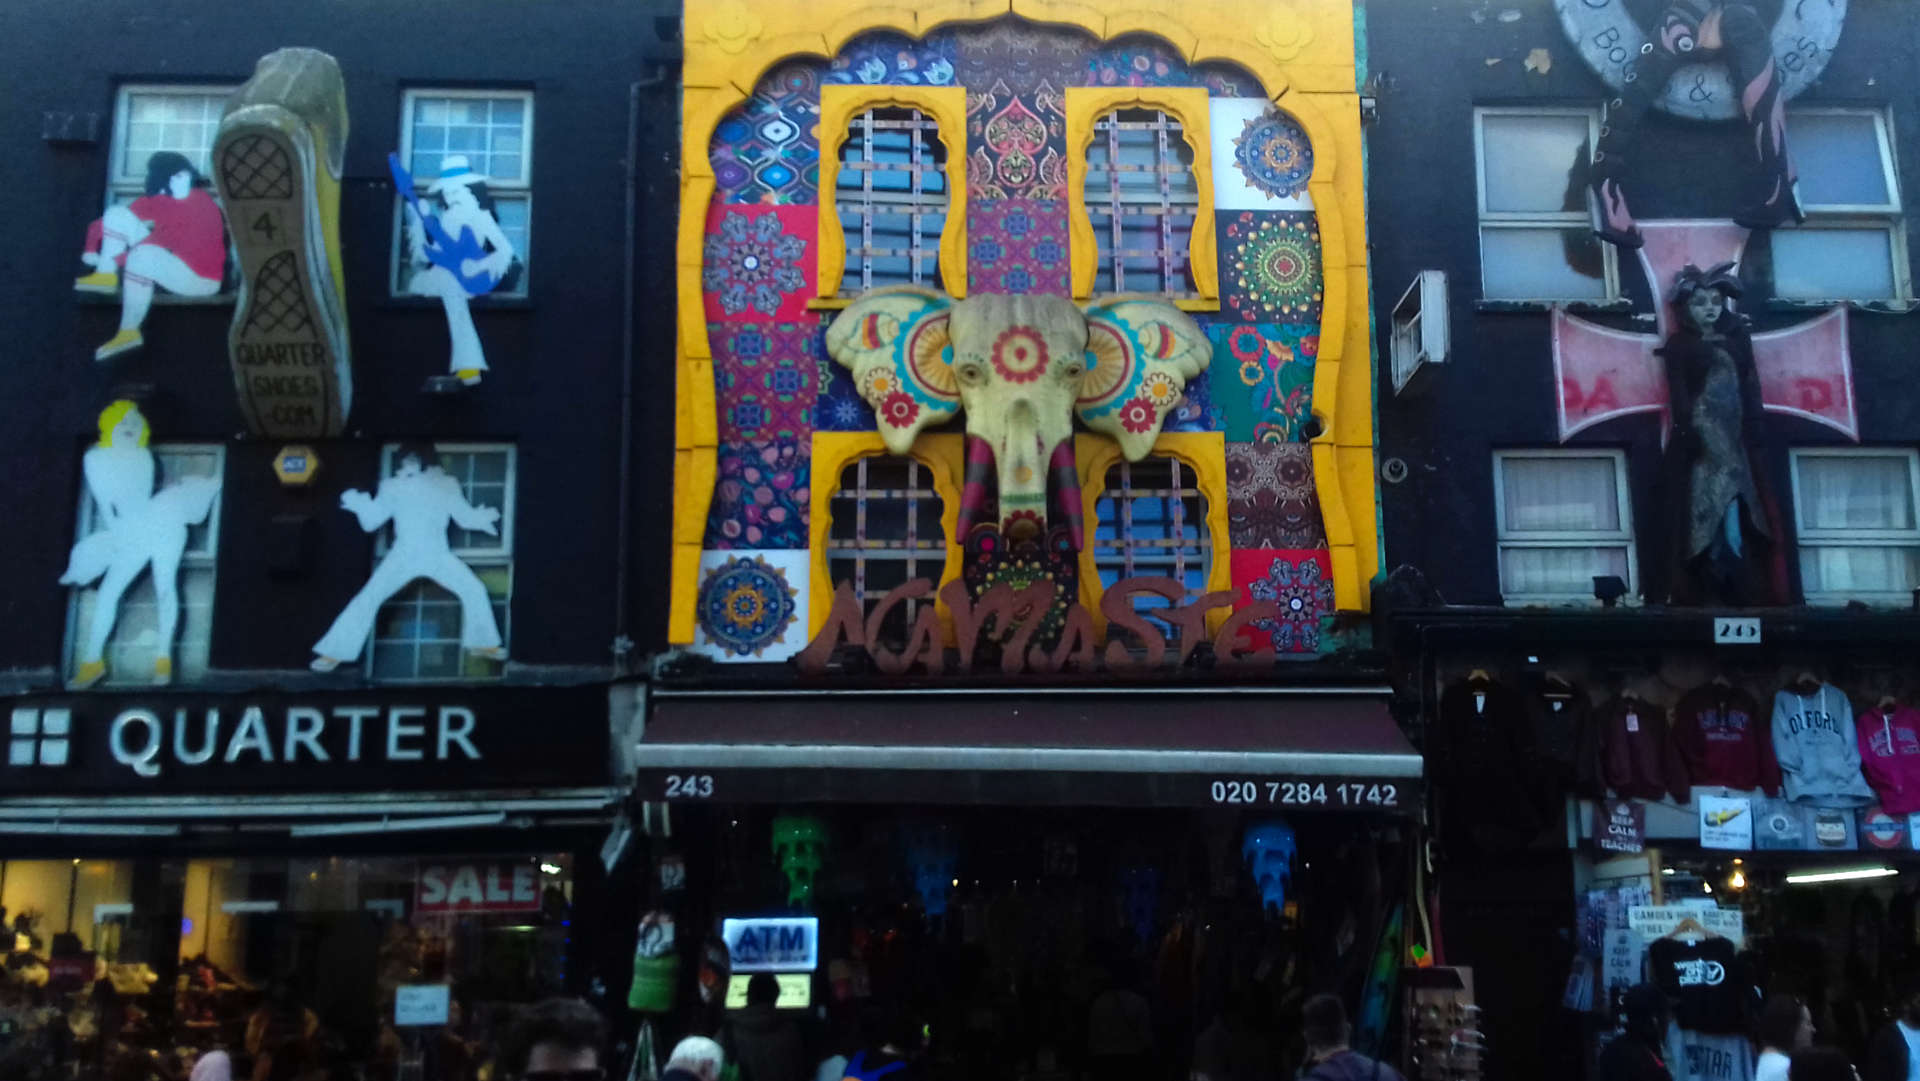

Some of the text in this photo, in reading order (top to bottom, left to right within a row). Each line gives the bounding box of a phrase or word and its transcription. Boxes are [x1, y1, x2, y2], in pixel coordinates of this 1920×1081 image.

[1688, 73, 1713, 104] &
[254, 211, 278, 240] 4
[237, 343, 325, 367] QUARTER
[254, 375, 318, 397] SHOES
[797, 575, 1281, 677] NAMASTE
[109, 706, 482, 777] QUARTER
[664, 774, 715, 799] 243
[1211, 780, 1399, 806] 020 7284 1742
[1607, 824, 1637, 837] CALM
[420, 865, 537, 904] SALE
[736, 925, 804, 953] ATM
